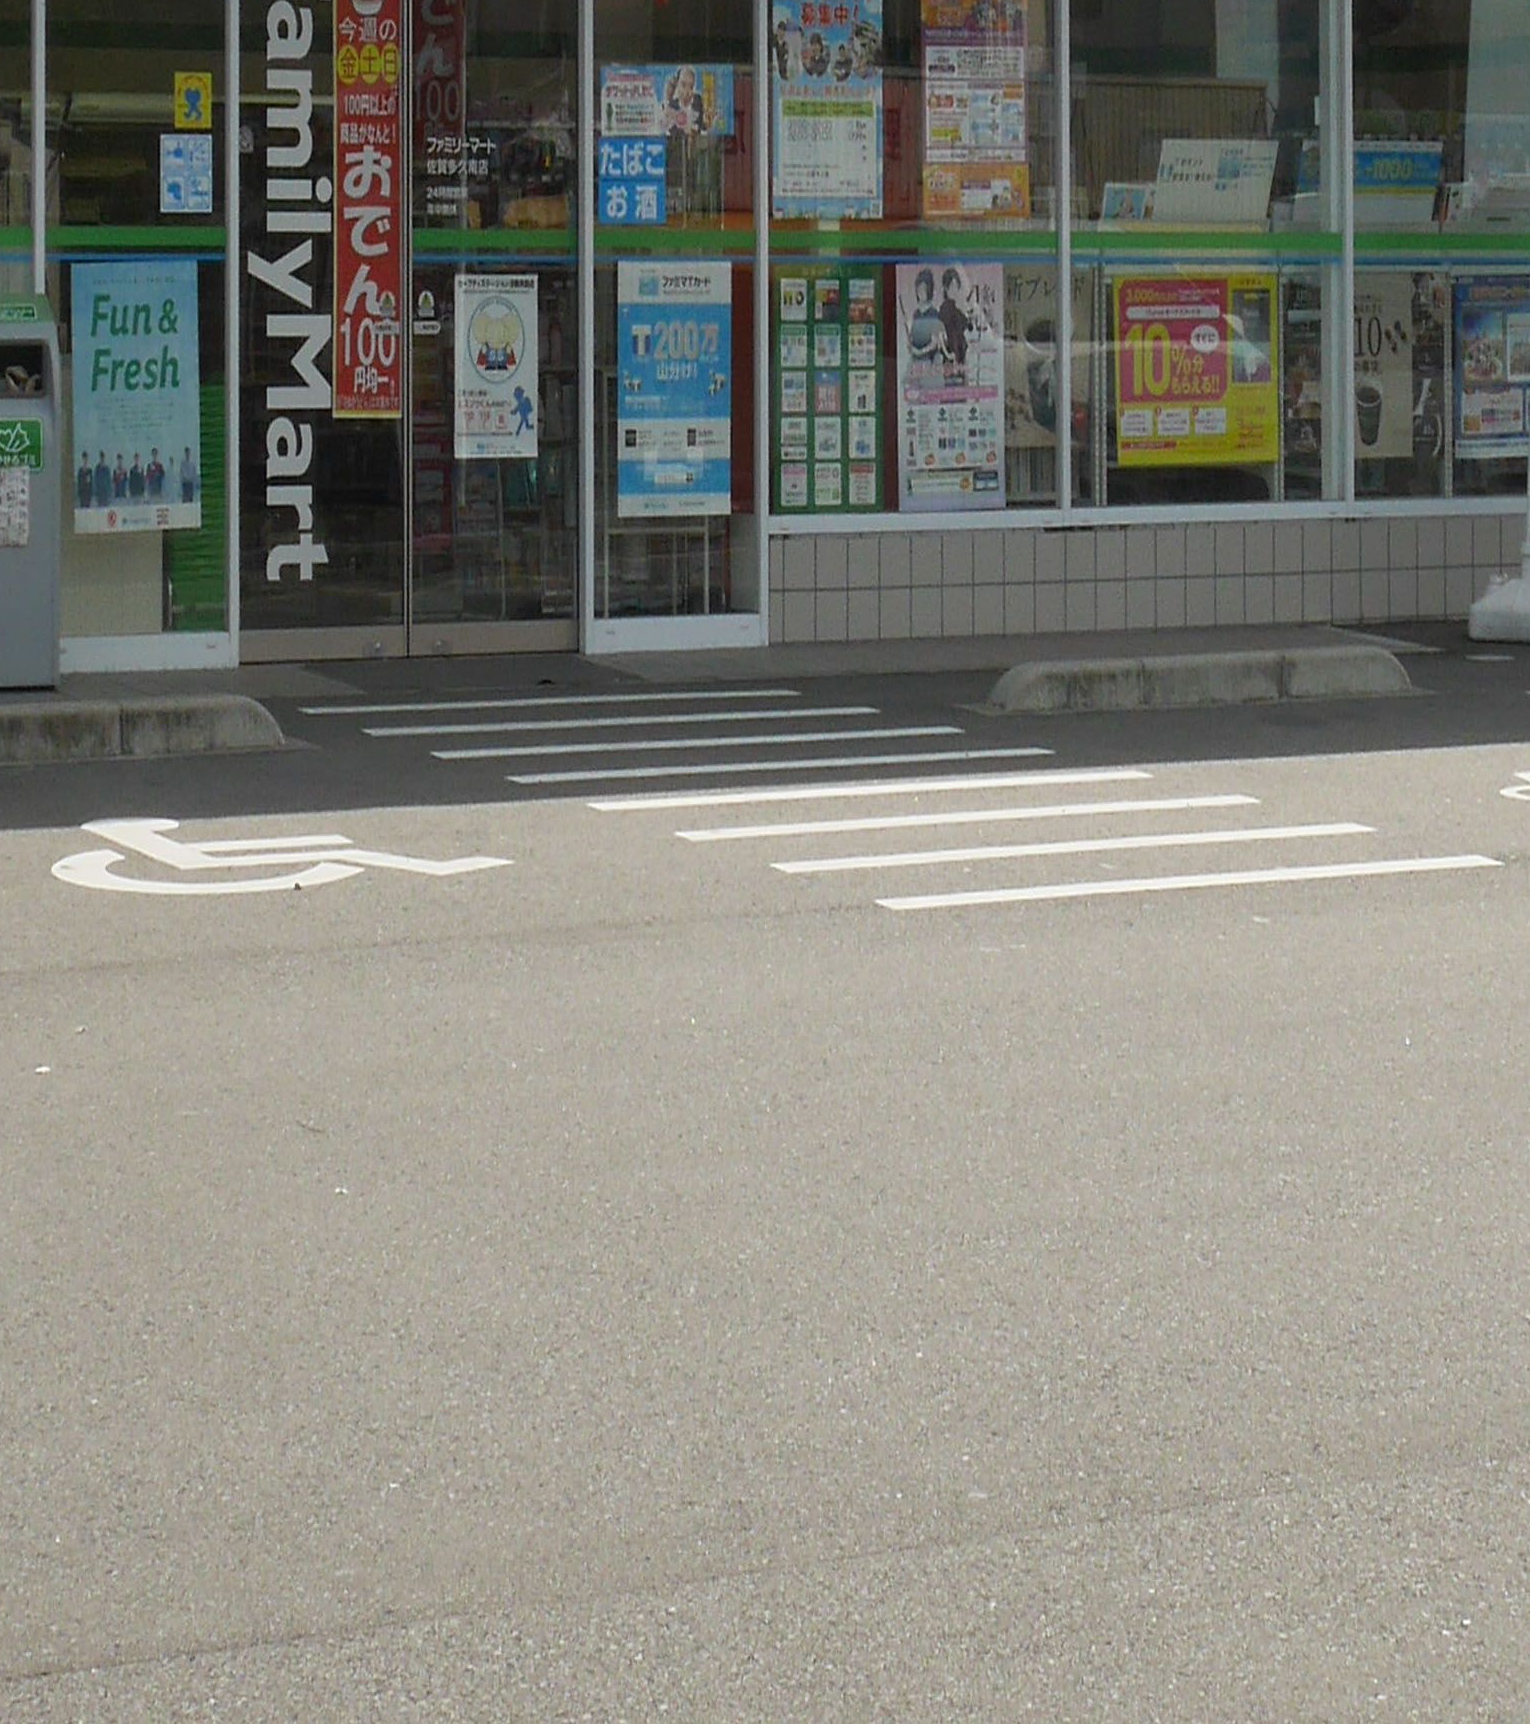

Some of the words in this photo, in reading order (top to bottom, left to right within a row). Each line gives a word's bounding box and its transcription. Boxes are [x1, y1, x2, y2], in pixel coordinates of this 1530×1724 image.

[339, 17, 397, 42] 今週の
[426, 137, 497, 155] ファミリーマート
[600, 142, 664, 176] たばこ
[606, 185, 658, 220] お酒
[343, 145, 393, 316] おでん
[90, 293, 152, 338] Fun
[157, 298, 179, 335] &
[90, 345, 180, 392] Fresh
